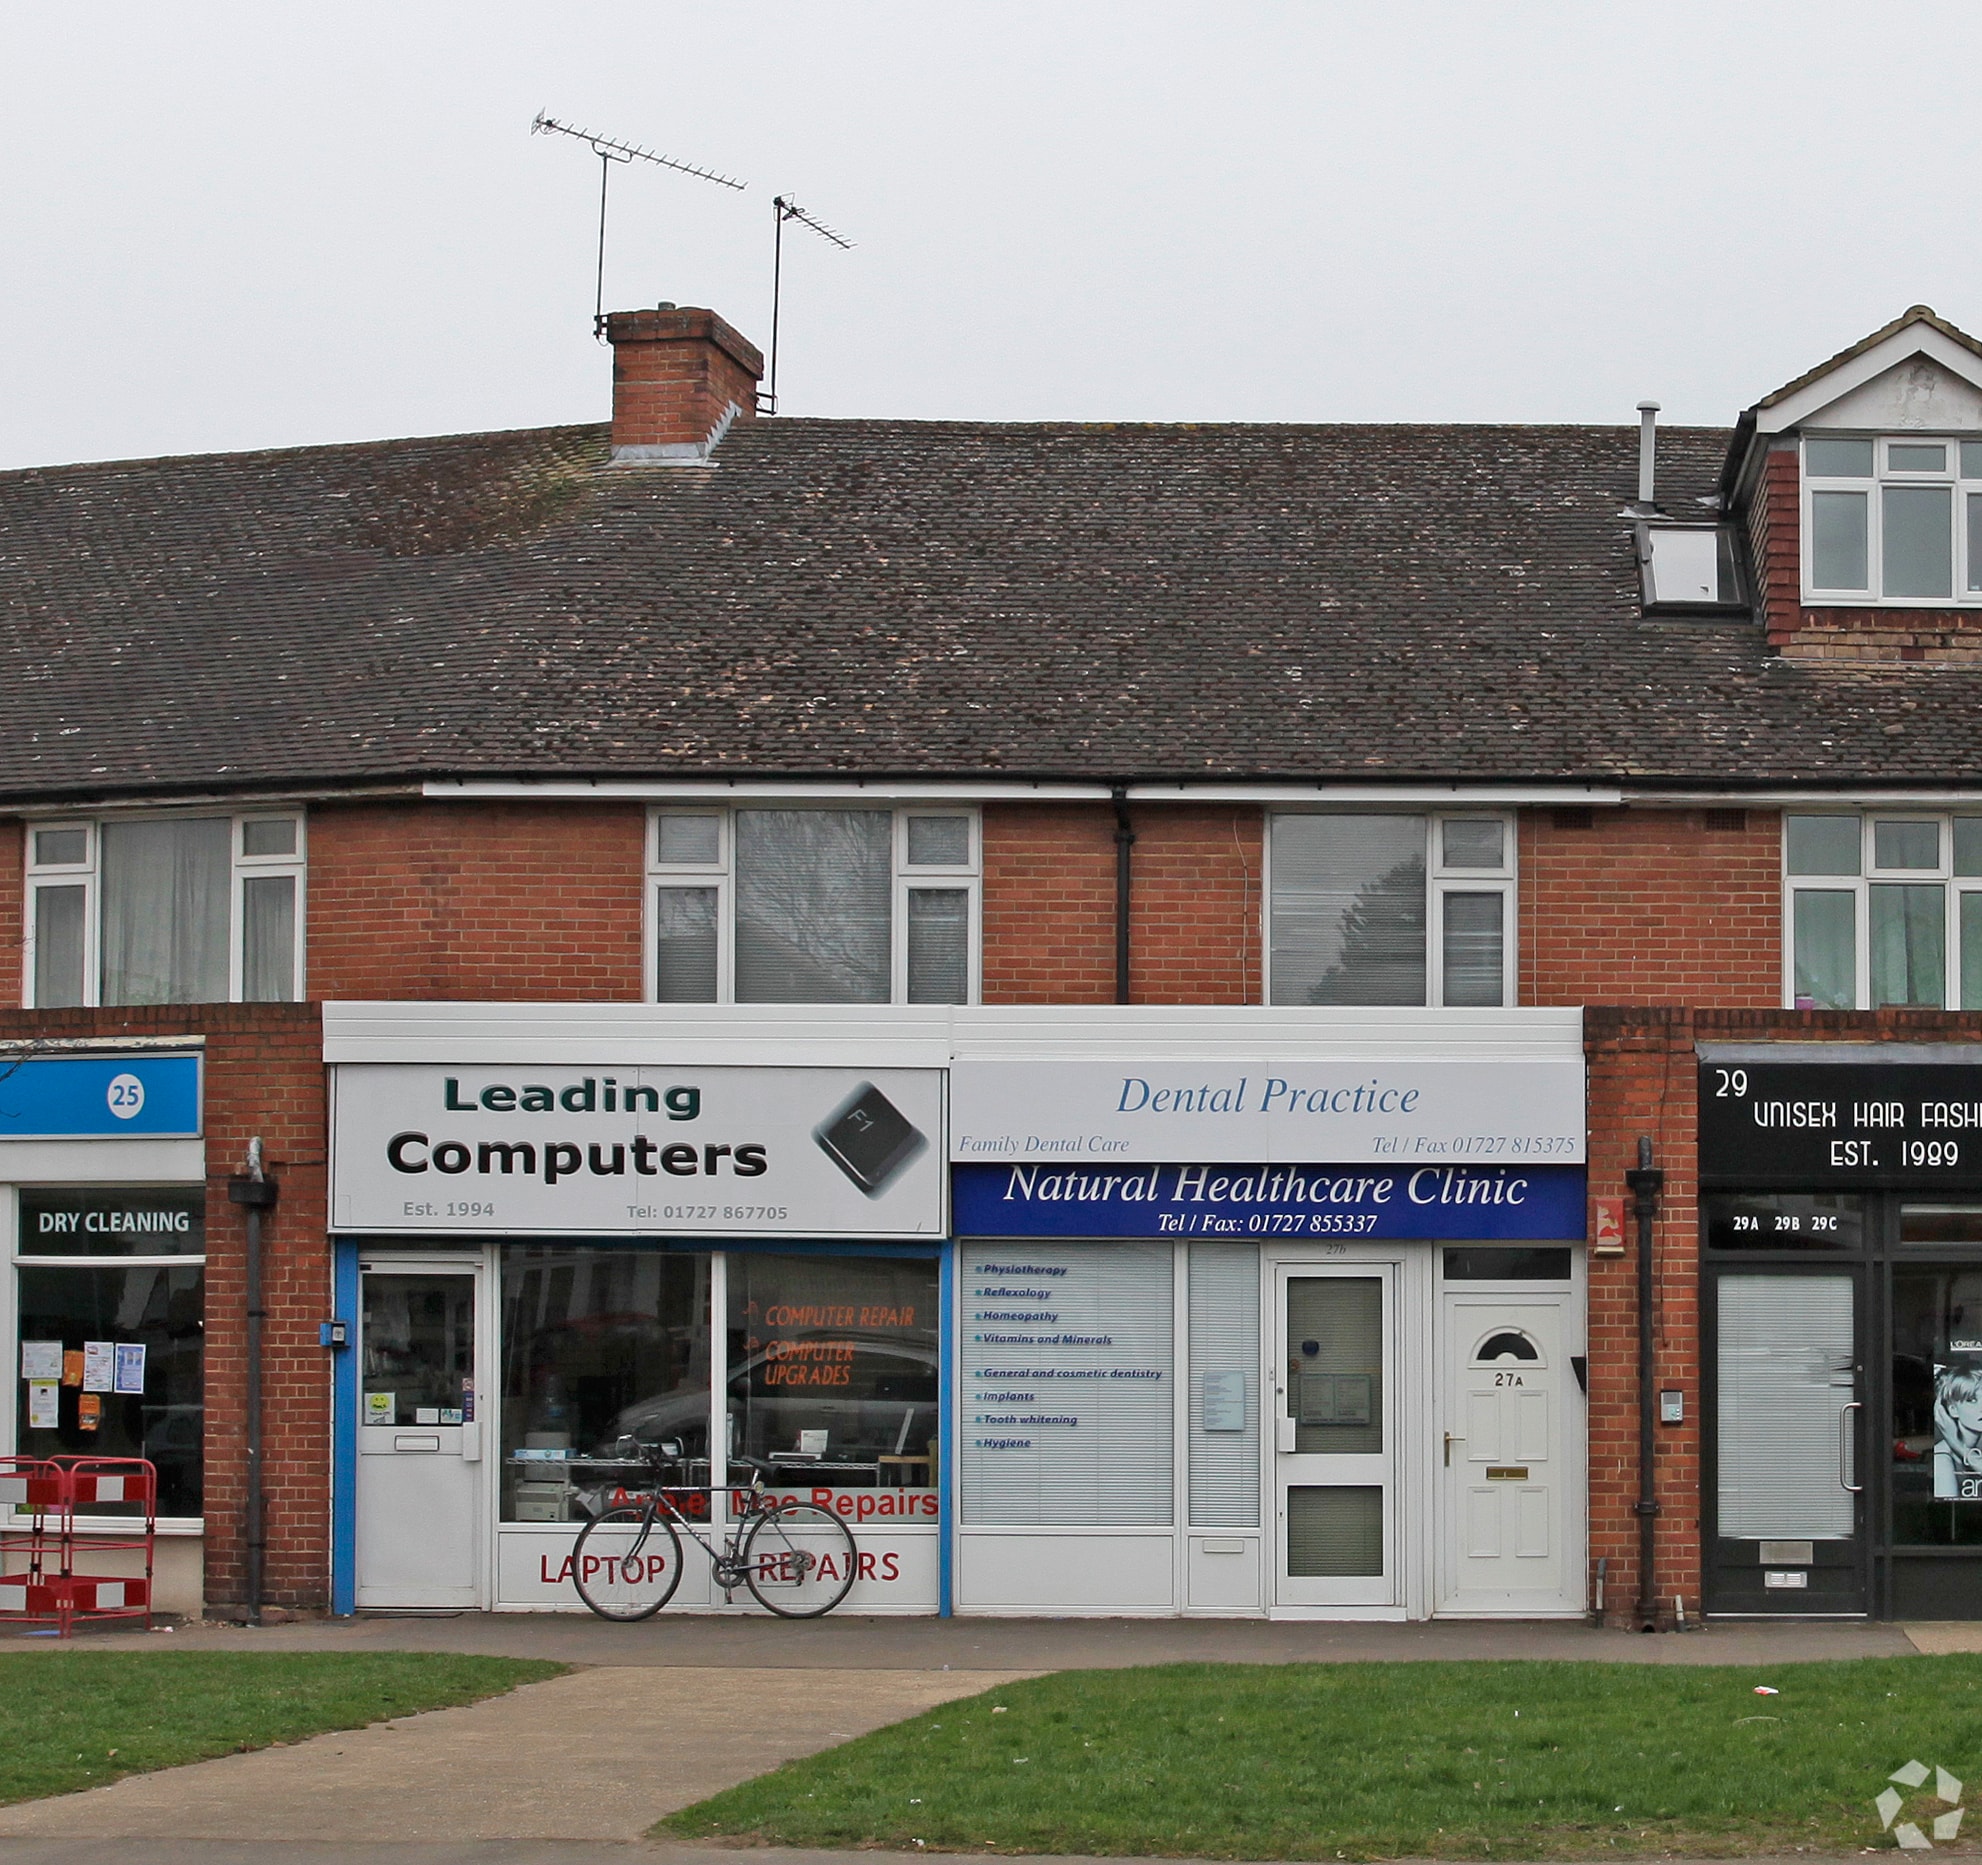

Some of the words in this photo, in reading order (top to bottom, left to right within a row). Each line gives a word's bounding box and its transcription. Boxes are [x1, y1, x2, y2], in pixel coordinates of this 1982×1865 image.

[1715, 1069, 1748, 1098] 29
[112, 1084, 139, 1107] 25
[443, 1076, 701, 1122] Leading
[1116, 1077, 1245, 1113] Dental
[1258, 1077, 1421, 1113] Practice
[847, 1108, 875, 1132] F1
[1754, 1101, 1837, 1128] UNISEX
[1853, 1101, 1905, 1128] HAIR
[959, 1135, 1021, 1156] Family
[1024, 1135, 1083, 1152] Dental
[1087, 1136, 1130, 1153] Care
[1372, 1136, 1398, 1154] Tel
[1414, 1136, 1449, 1154] Fax
[1452, 1137, 1505, 1155] 01727
[1510, 1137, 1576, 1155] 815375
[1830, 1140, 1879, 1167] EST.
[1902, 1140, 1959, 1167] 1989
[386, 1130, 768, 1185] Computers
[1002, 1164, 1159, 1202] Natural
[1170, 1165, 1394, 1204] Healthcare
[1407, 1167, 1528, 1205] Clinic
[403, 1201, 438, 1217] Est.
[446, 1201, 495, 1217] 1994
[627, 1205, 658, 1219] Tel:
[663, 1205, 717, 1219] 01727
[723, 1206, 788, 1220] 867705
[38, 1211, 80, 1233] DRY
[84, 1211, 190, 1233] CLEANING
[1158, 1214, 1187, 1232] Tel
[1202, 1214, 1244, 1232] Fax:
[1248, 1214, 1306, 1233] 01727
[1309, 1214, 1378, 1233] 855337
[1733, 1215, 1759, 1231] 29A
[1774, 1215, 1800, 1231] 29B
[1811, 1215, 1838, 1231] 29C
[984, 1263, 1067, 1276] Physiotherapy
[984, 1287, 1051, 1300] Reflexology
[764, 1306, 854, 1326] COMPUTER
[859, 1306, 915, 1326] REPAIR
[984, 1310, 1058, 1323] Homeopathy
[984, 1333, 1034, 1344] Vitamins
[1037, 1334, 1059, 1345] and
[1062, 1334, 1112, 1345] Minerals
[764, 1340, 855, 1361] COMPUTER
[764, 1365, 851, 1385] UPGRADES
[984, 1368, 1029, 1379] General
[1031, 1368, 1055, 1379] and
[1057, 1368, 1107, 1379] cosmetic
[1110, 1368, 1162, 1380] dentistry
[1494, 1372, 1524, 1388] 27A
[984, 1414, 1018, 1425] Tooth
[1020, 1414, 1078, 1427] whitening
[984, 1437, 1031, 1449] Hygiene
[811, 1487, 939, 1522] Repairs
[541, 1554, 665, 1585] LAPTOP
